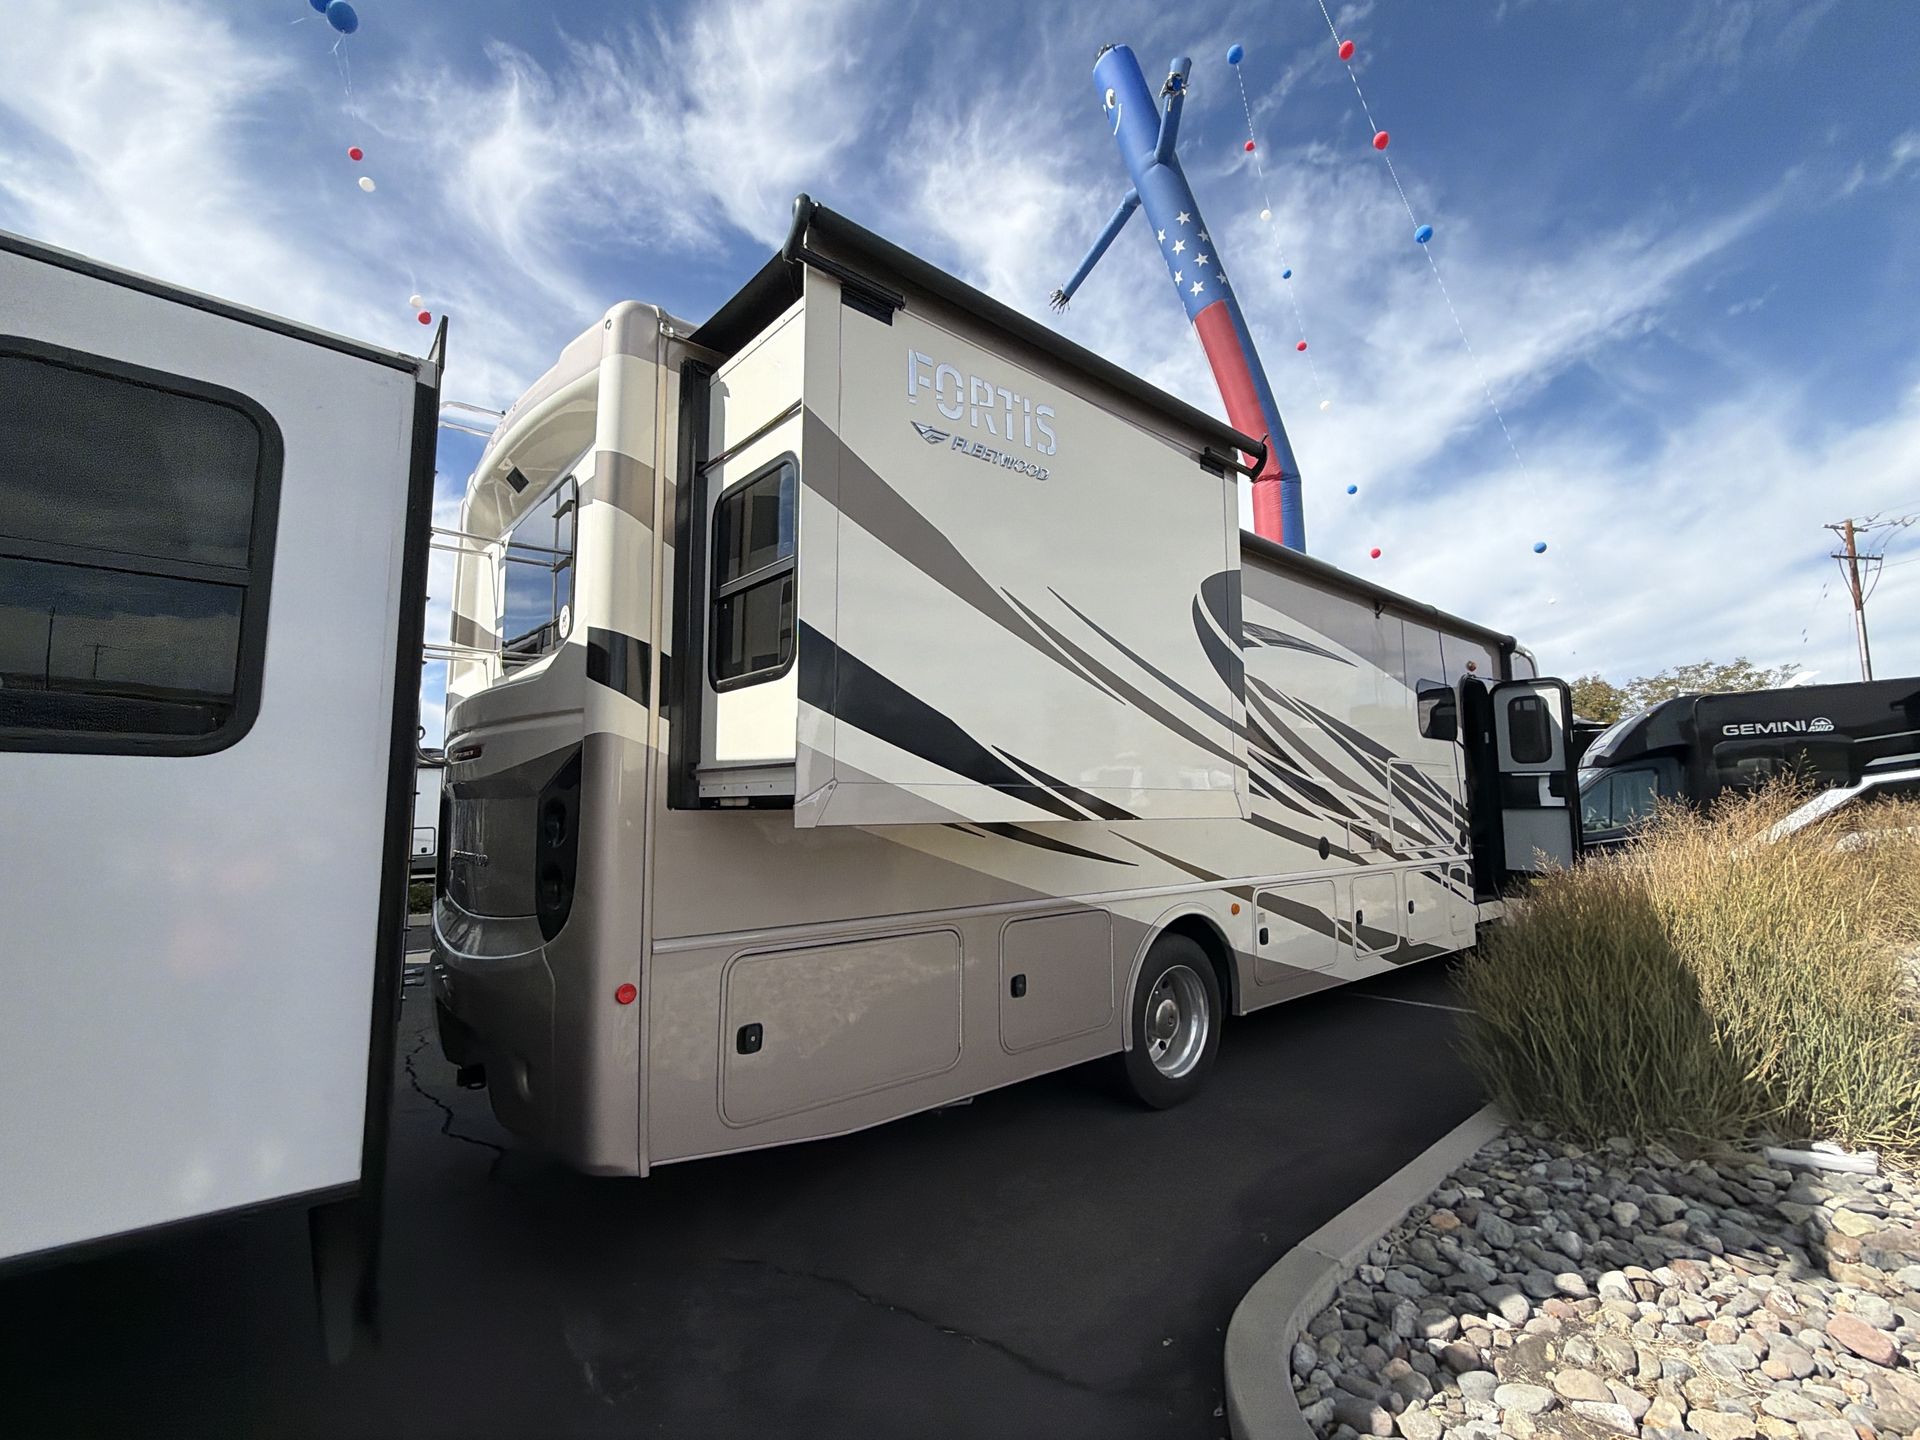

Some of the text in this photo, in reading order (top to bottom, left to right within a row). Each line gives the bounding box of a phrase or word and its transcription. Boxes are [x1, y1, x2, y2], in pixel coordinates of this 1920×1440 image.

[907, 349, 1057, 456] FORTIS
[951, 436, 1050, 481] FLEETWOOD
[1722, 720, 1835, 736] GEMINI AWD
